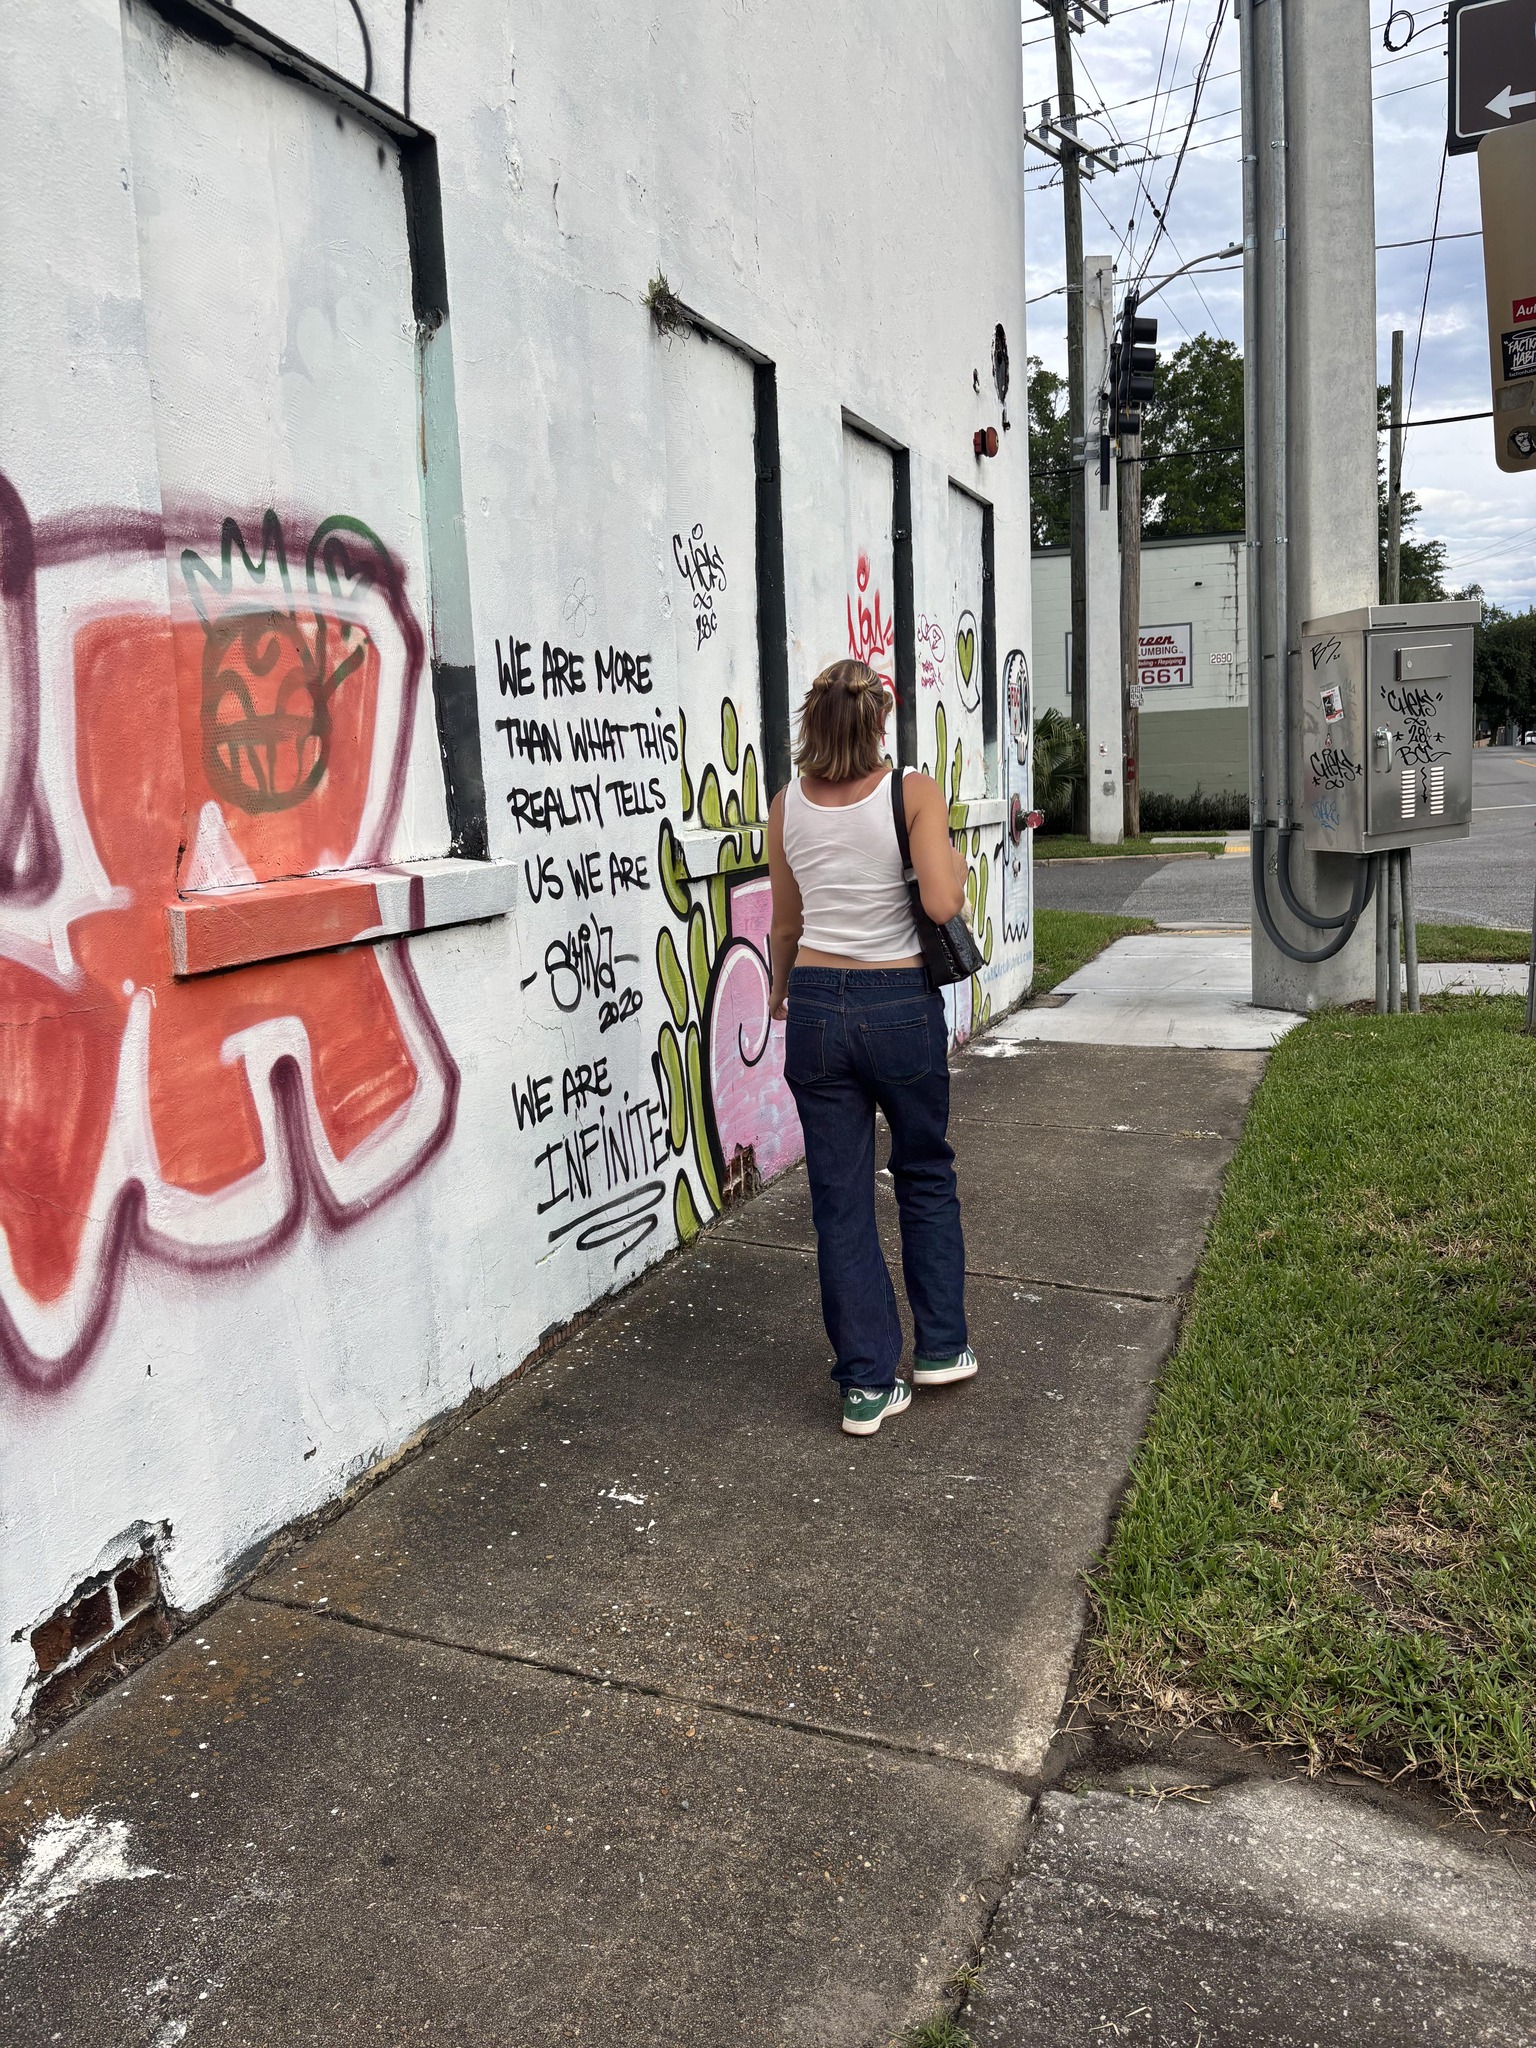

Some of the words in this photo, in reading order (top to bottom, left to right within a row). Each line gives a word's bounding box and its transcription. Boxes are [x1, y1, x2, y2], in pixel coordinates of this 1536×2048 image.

[1138, 635, 1174, 646] reen
[1138, 645, 1178, 656] UMBING
[495, 635, 535, 698] WE
[542, 640, 586, 700] ARE
[594, 645, 653, 694] MORE
[1138, 668, 1184, 685] 661
[495, 716, 562, 766] THAN
[566, 717, 629, 763] WHAT
[506, 773, 604, 834] REALITY
[605, 777, 666, 817] TELLS
[524, 853, 564, 904] US
[566, 851, 603, 901] WE
[609, 851, 650, 898] ARE
[598, 986, 643, 1034] 2020
[511, 1074, 553, 1131] WE
[562, 1056, 612, 1116] ARE
